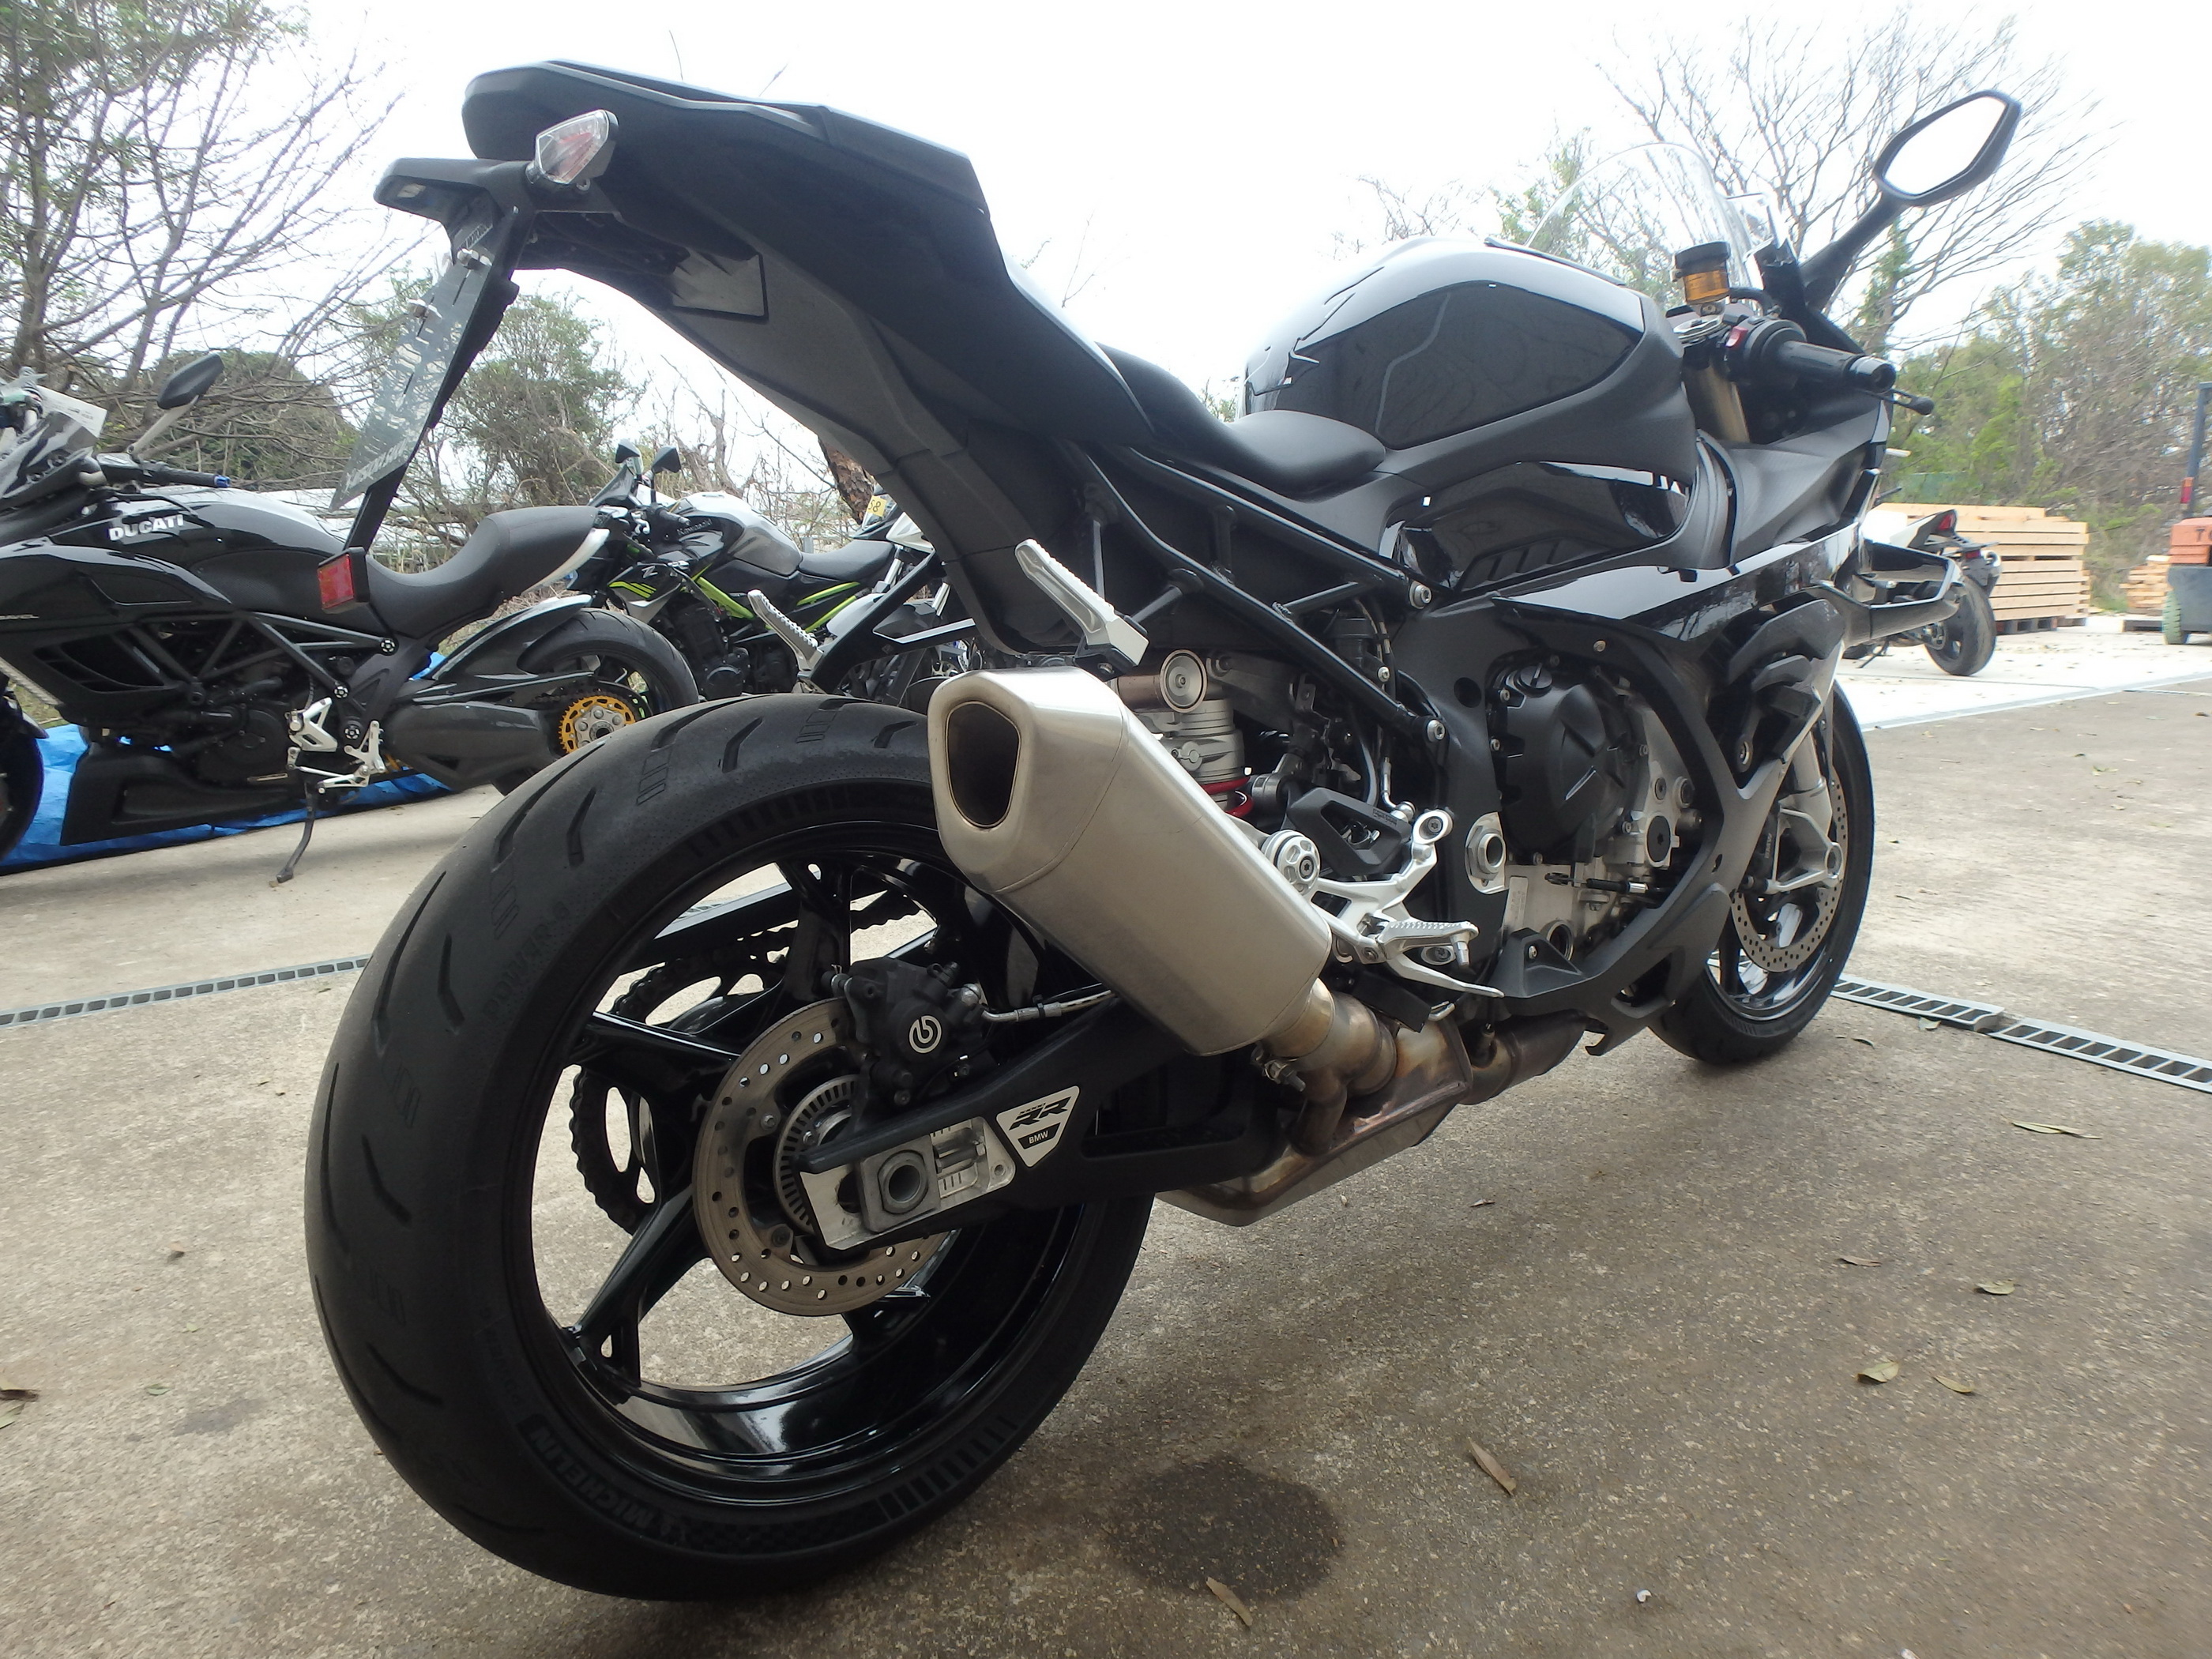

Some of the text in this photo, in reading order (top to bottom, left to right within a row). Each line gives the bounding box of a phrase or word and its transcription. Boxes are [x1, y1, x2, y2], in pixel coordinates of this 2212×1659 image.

[108, 514, 184, 541] DUCATI
[1009, 1096, 1071, 1130] RR
[1029, 1130, 1048, 1144] BMW
[529, 1426, 656, 1529] MICHELIN
